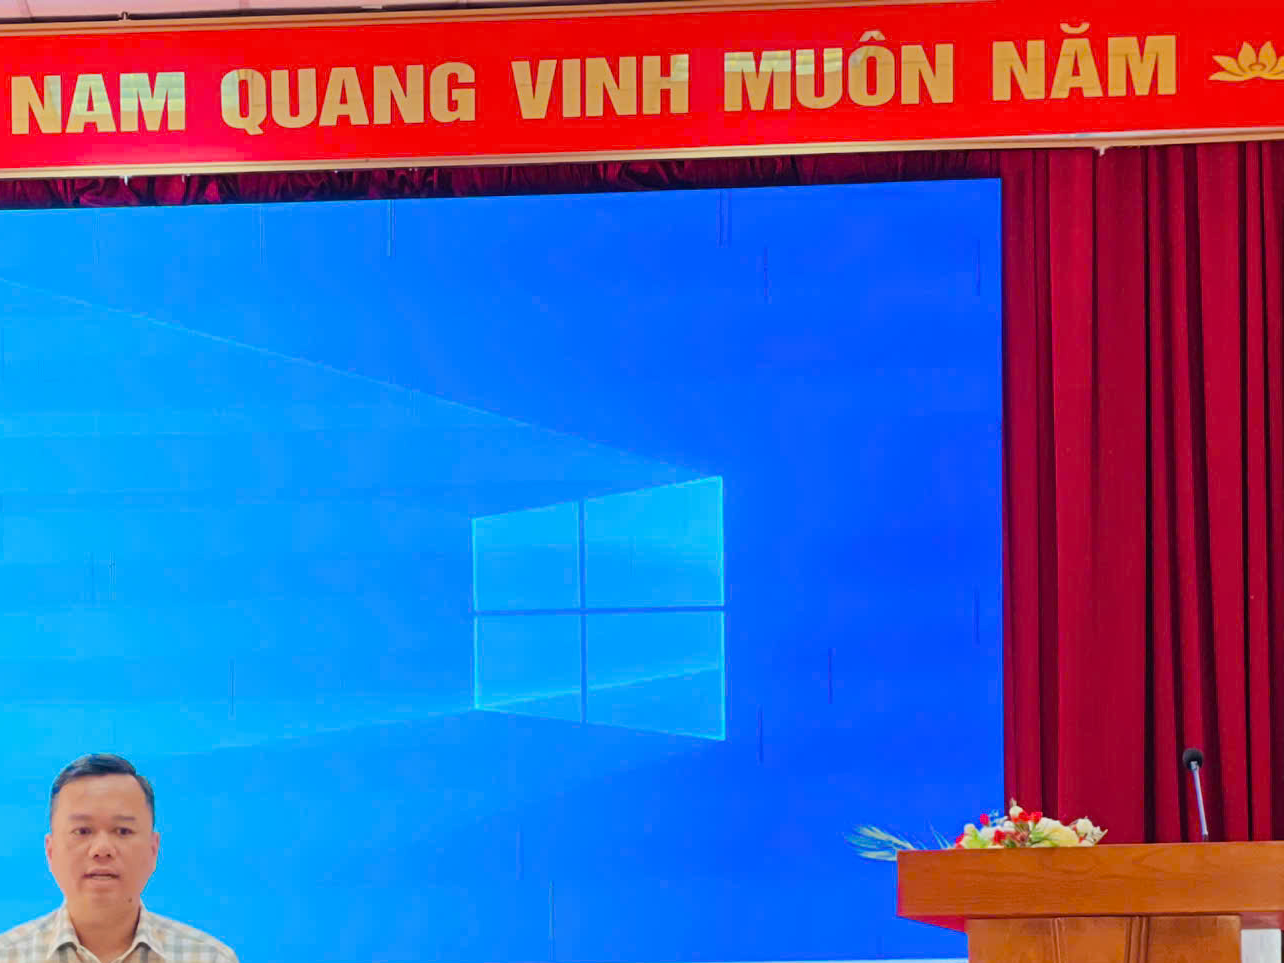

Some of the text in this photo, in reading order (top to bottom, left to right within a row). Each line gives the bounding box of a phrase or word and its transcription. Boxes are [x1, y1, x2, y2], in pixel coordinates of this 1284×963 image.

[11, 71, 186, 135] NAM
[220, 62, 476, 136] QUANG
[511, 53, 690, 120] VINH
[723, 30, 954, 112] MUÔN
[992, 23, 1177, 101] NĂM
